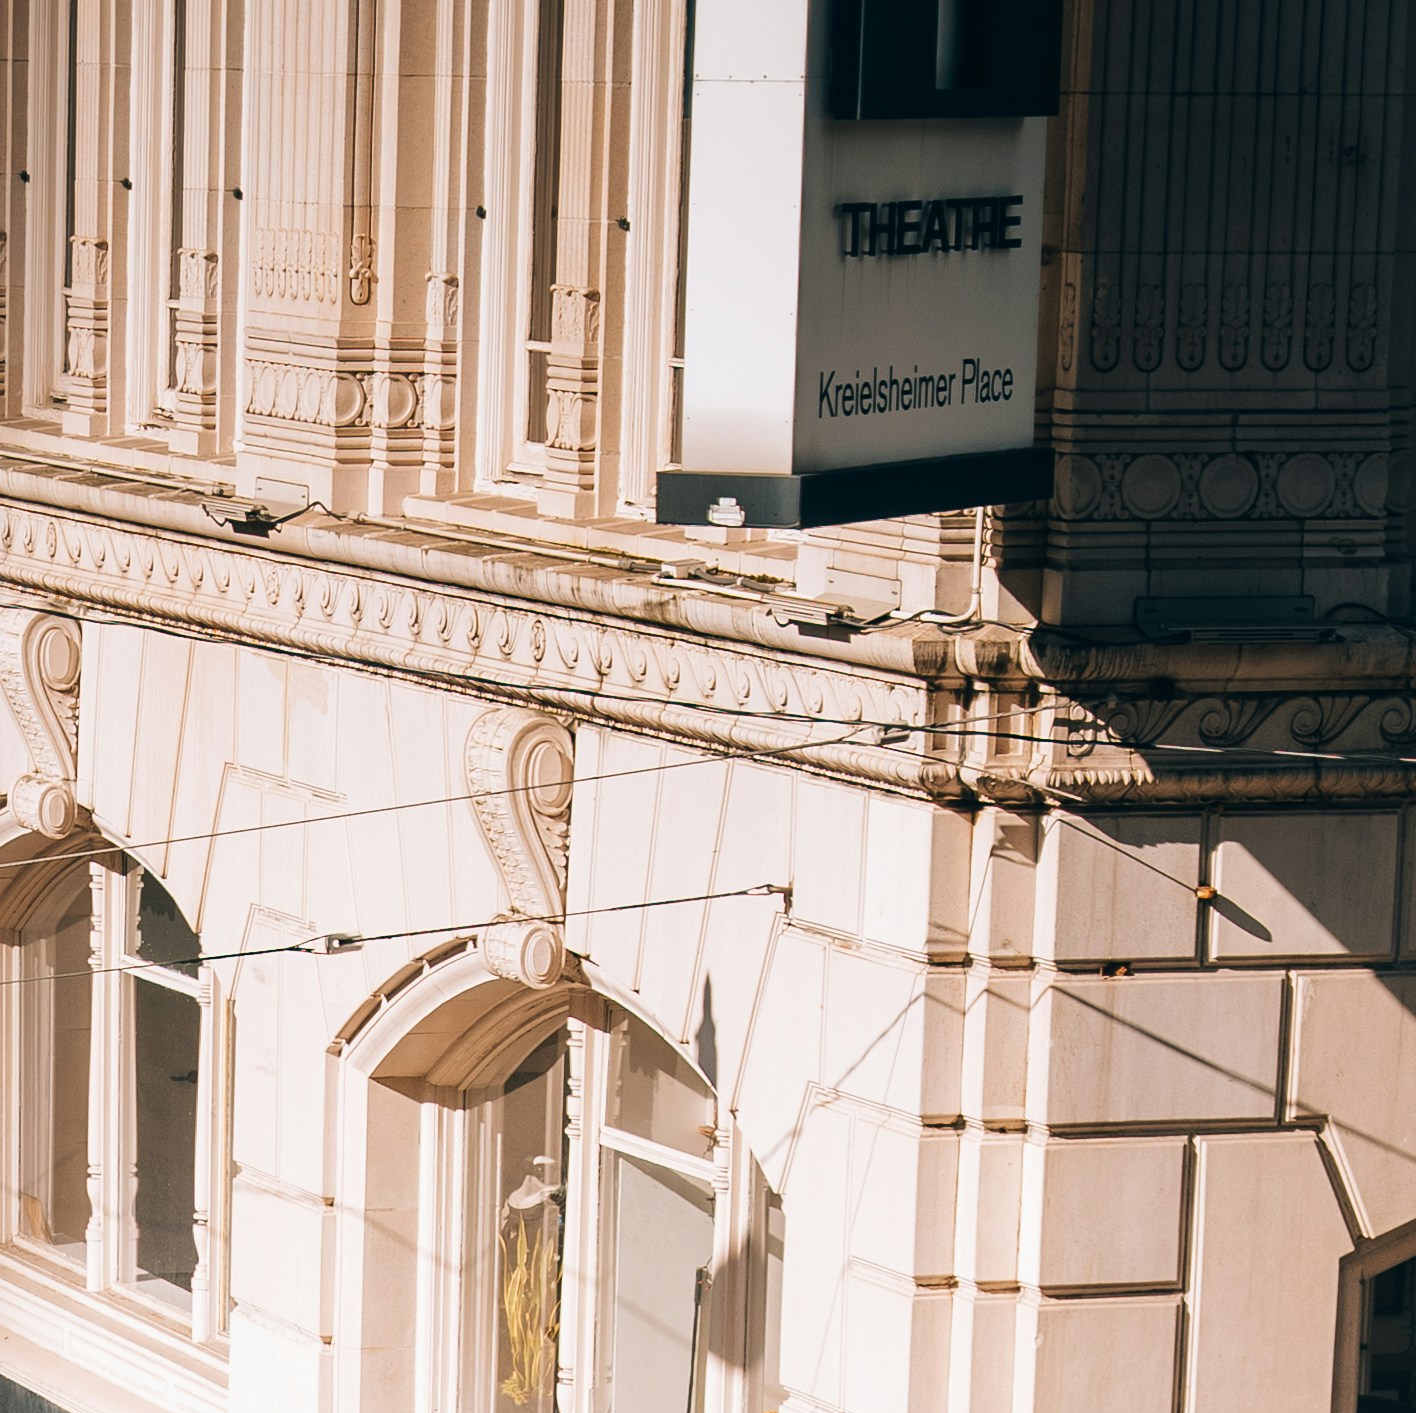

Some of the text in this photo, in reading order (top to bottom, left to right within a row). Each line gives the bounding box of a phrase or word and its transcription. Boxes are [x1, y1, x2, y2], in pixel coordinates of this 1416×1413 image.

[840, 195, 1023, 257] THEATRE
[819, 357, 1014, 418] Kreielsheimer Place
